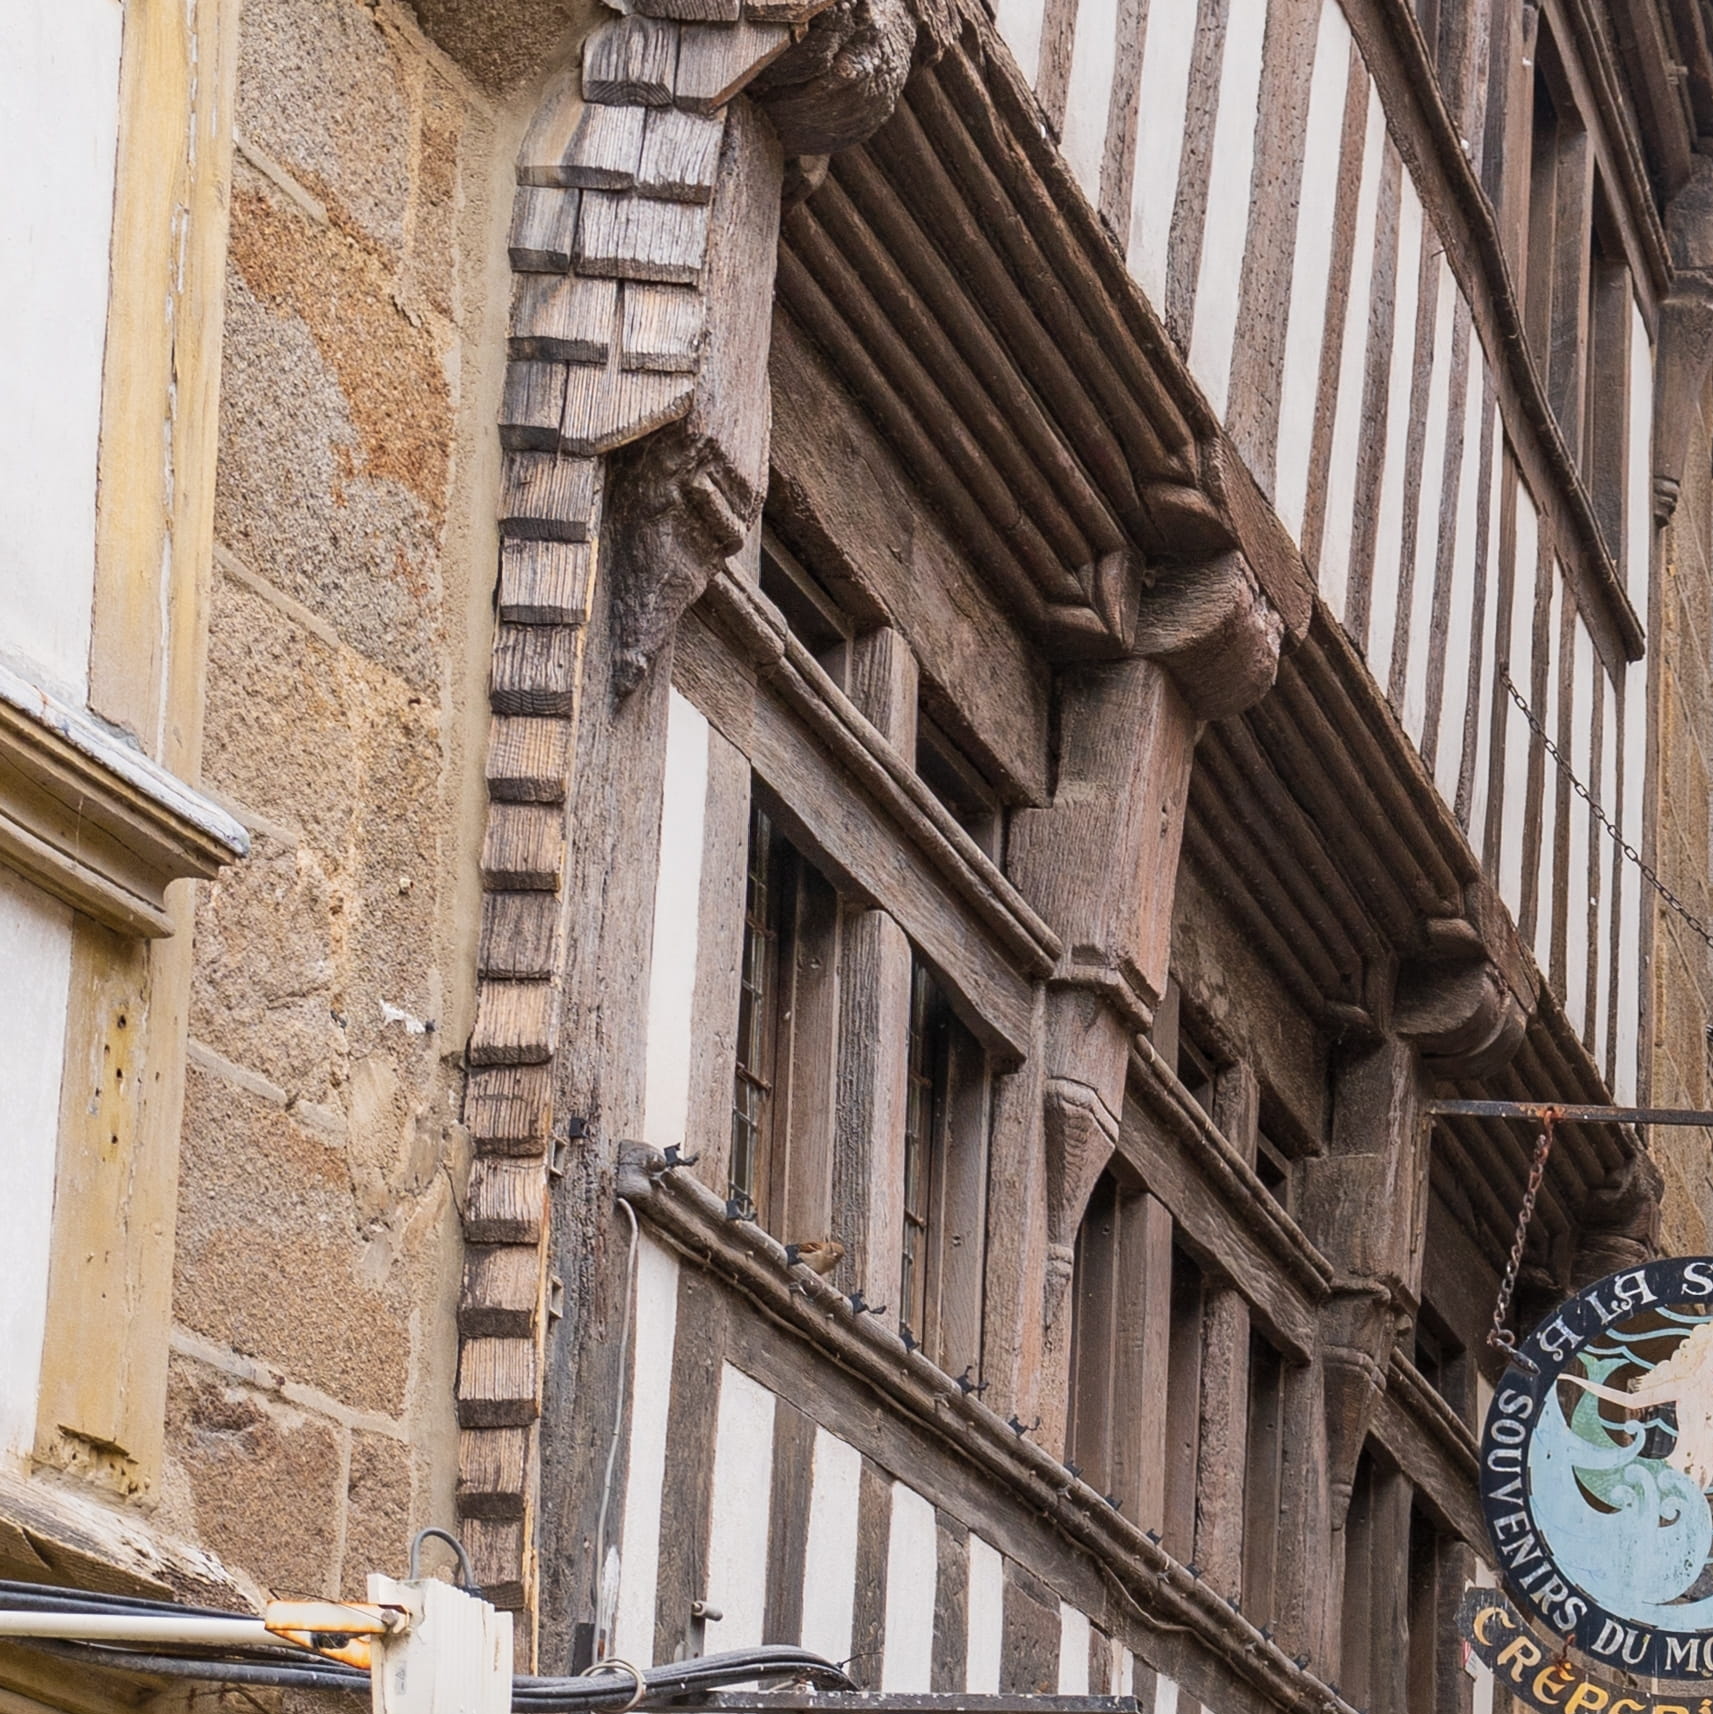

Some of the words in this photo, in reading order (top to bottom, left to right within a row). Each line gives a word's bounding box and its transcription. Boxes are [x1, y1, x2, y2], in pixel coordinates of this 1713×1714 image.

[1586, 1270, 1658, 1326] LA
[1486, 1387, 1588, 1632] SOUVENIRS
[1591, 1618, 1651, 1664] DU
